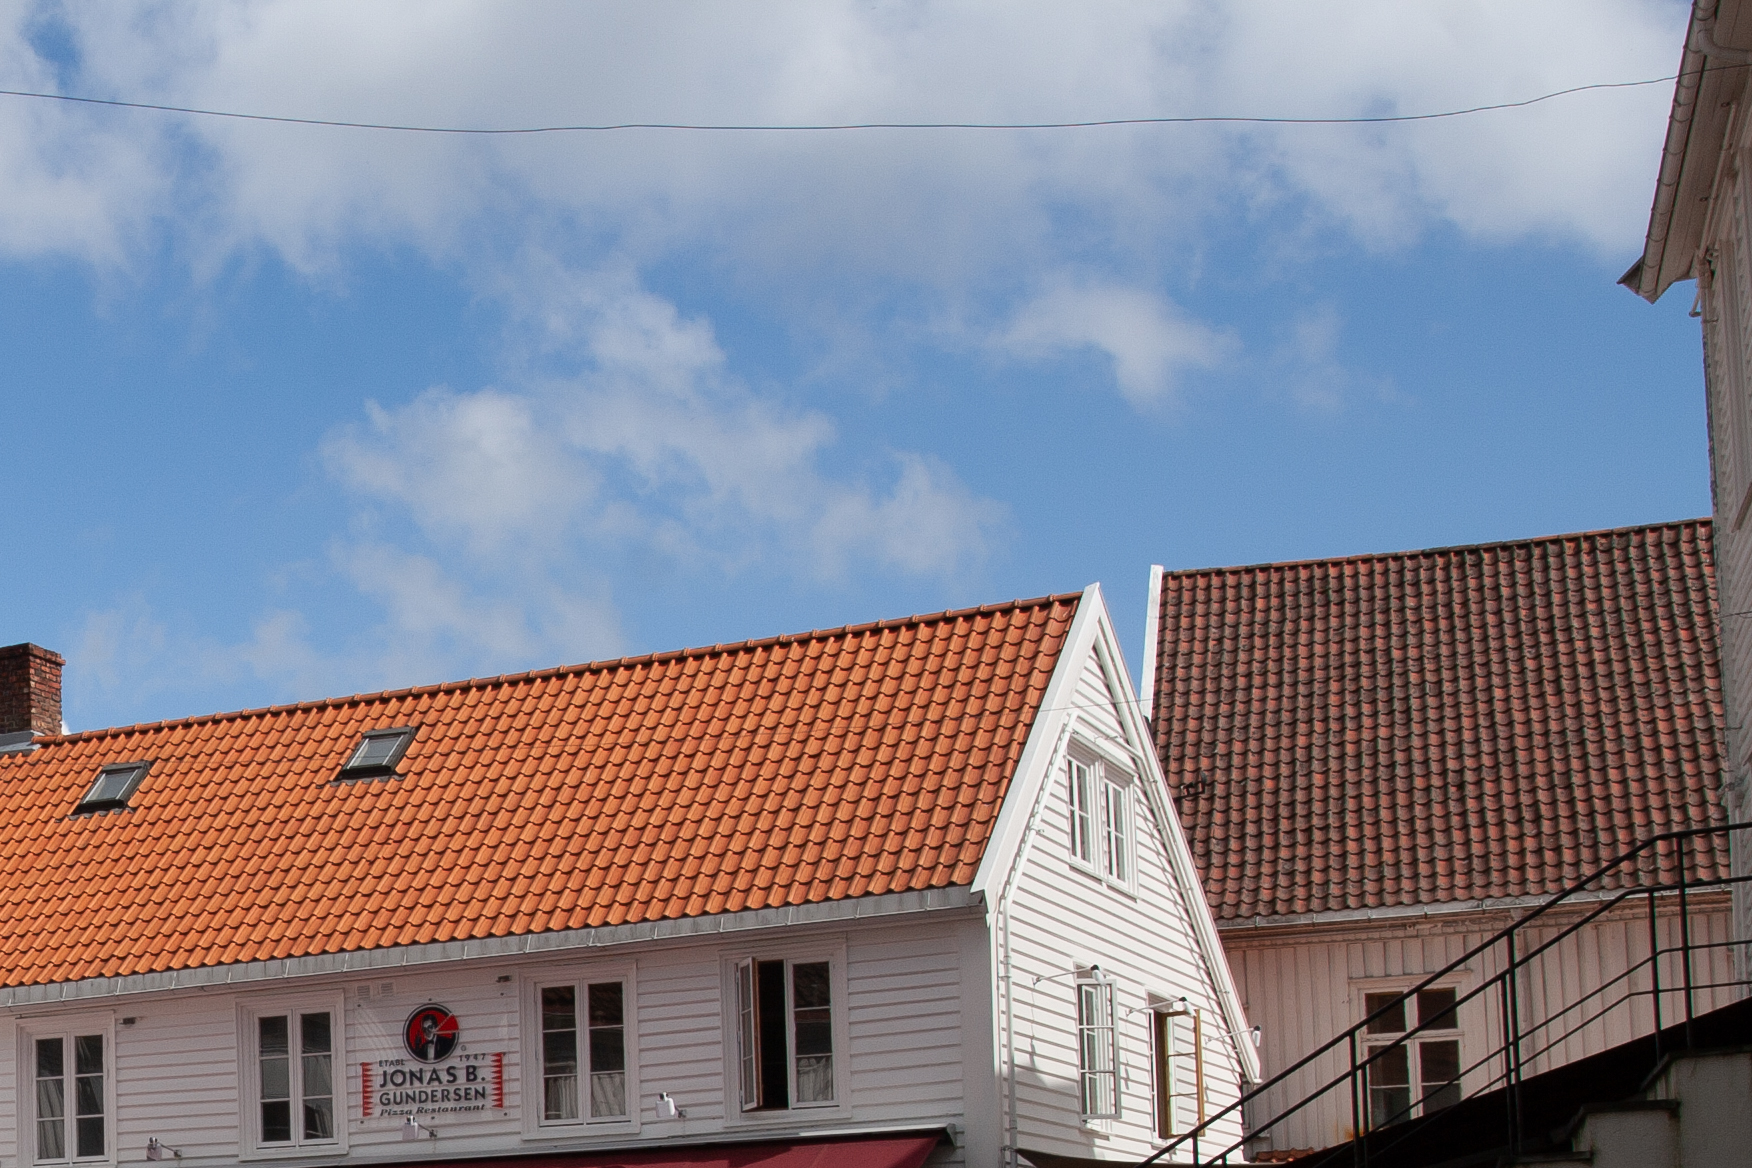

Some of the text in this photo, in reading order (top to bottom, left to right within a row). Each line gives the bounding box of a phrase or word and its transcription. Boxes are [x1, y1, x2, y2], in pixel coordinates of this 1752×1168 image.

[459, 1053, 486, 1061] 1947
[379, 1065, 487, 1089] JONAS B.
[380, 1087, 486, 1106] GUNDERSEN
[380, 1104, 486, 1117] Pizza Restaurant
